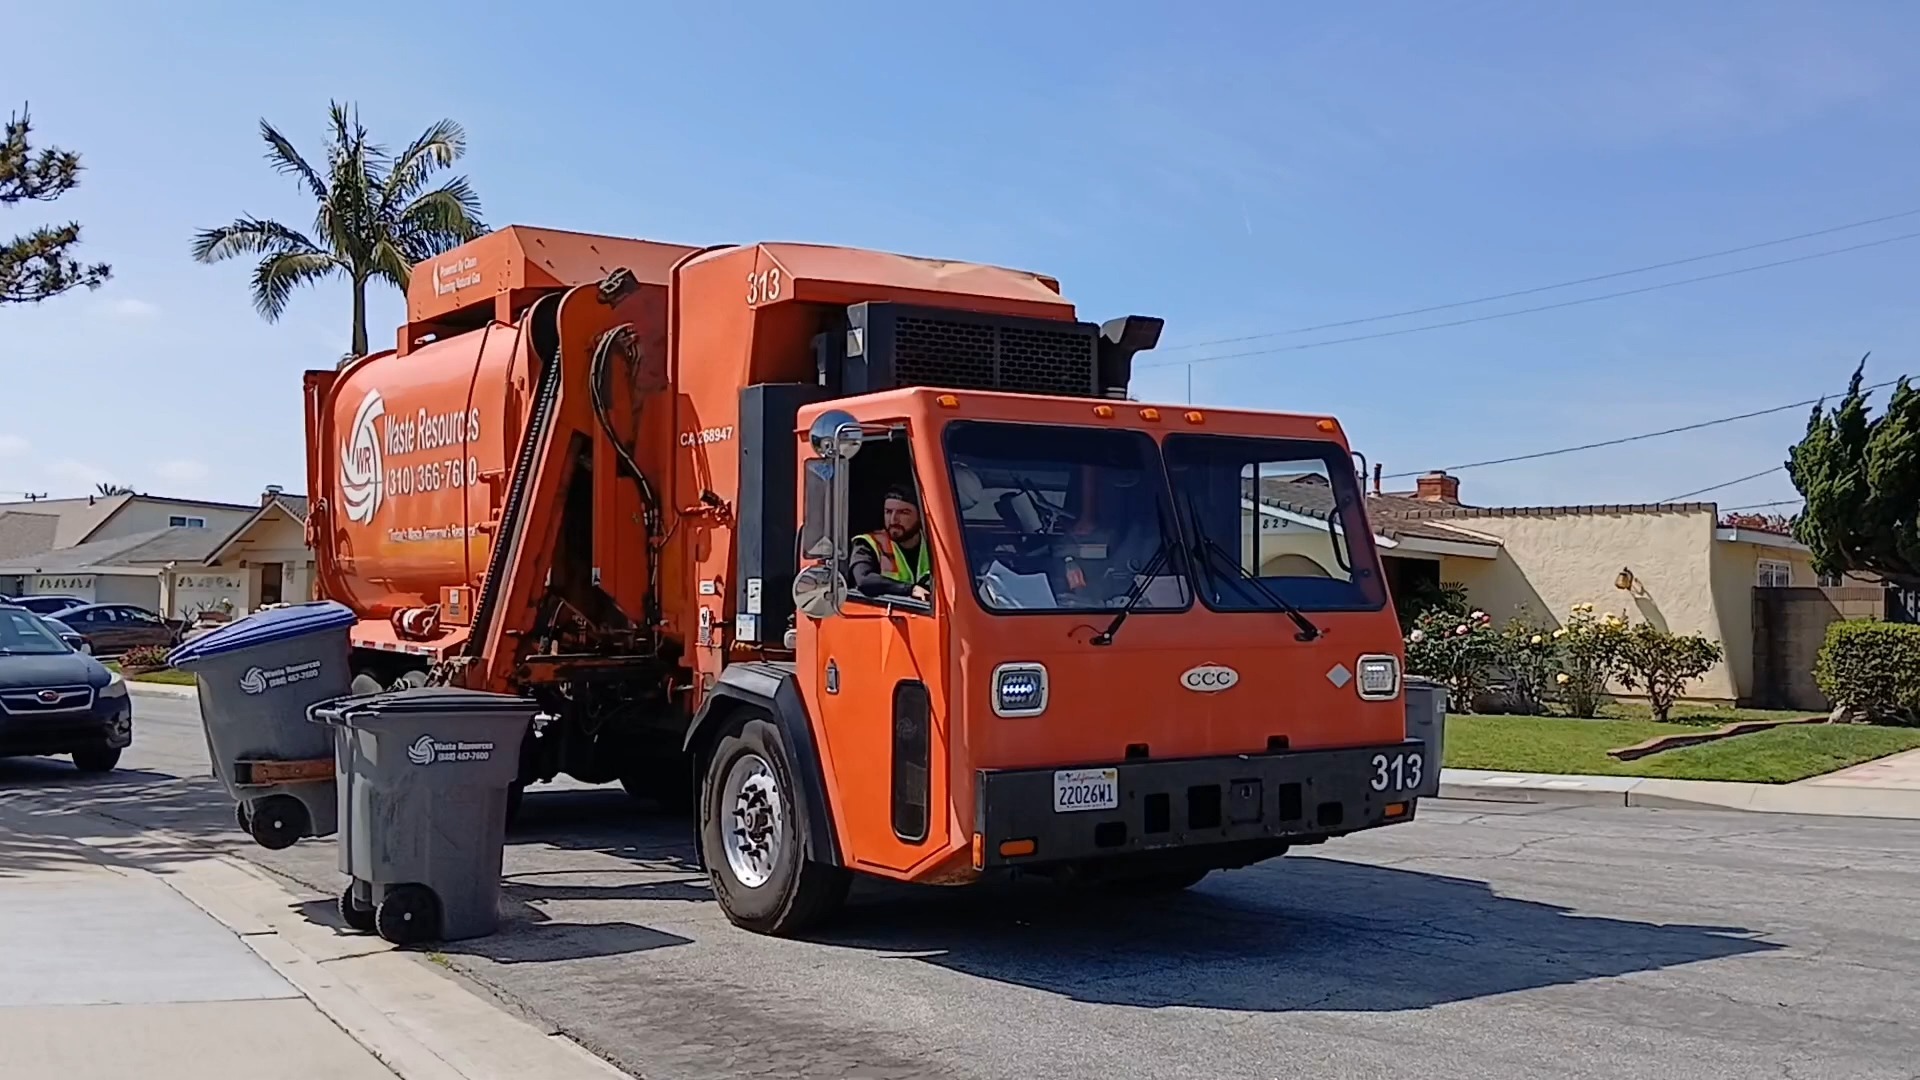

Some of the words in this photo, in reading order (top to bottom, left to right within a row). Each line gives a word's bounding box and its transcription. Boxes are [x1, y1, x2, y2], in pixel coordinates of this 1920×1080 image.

[746, 267, 780, 304] 313
[384, 413, 415, 456] Waste
[418, 408, 480, 450] Resources
[680, 432, 696, 446] CA
[697, 426, 733, 444] 268947
[356, 447, 372, 474] WR
[385, 466, 415, 497] (310)
[263, 669, 285, 679] Waste
[285, 660, 321, 673] Resources
[1187, 671, 1230, 686] CCC
[434, 742, 457, 751] Waste
[458, 742, 493, 750] Resources
[1371, 753, 1422, 790] 313
[1060, 784, 1113, 805] 22026W1
